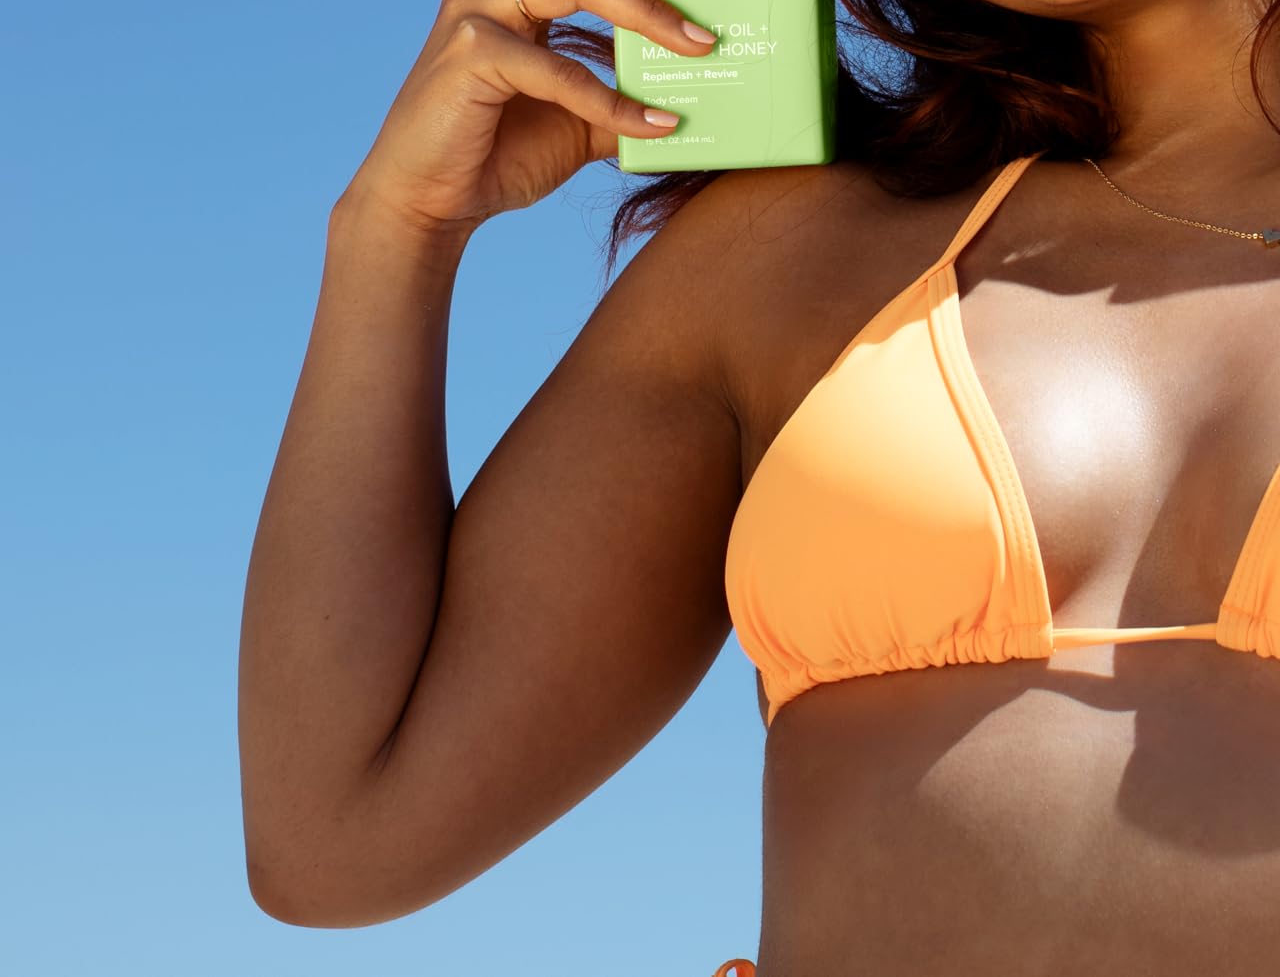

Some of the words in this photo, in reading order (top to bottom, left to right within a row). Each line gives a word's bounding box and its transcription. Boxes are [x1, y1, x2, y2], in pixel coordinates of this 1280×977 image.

[729, 23, 756, 37] OIL
[759, 24, 769, 35] +
[719, 41, 777, 56] HONEY
[642, 70, 693, 83] Replenish
[695, 71, 703, 80] +
[704, 69, 739, 80] Revive
[669, 95, 698, 104] Cream
[682, 135, 699, 144] (444
